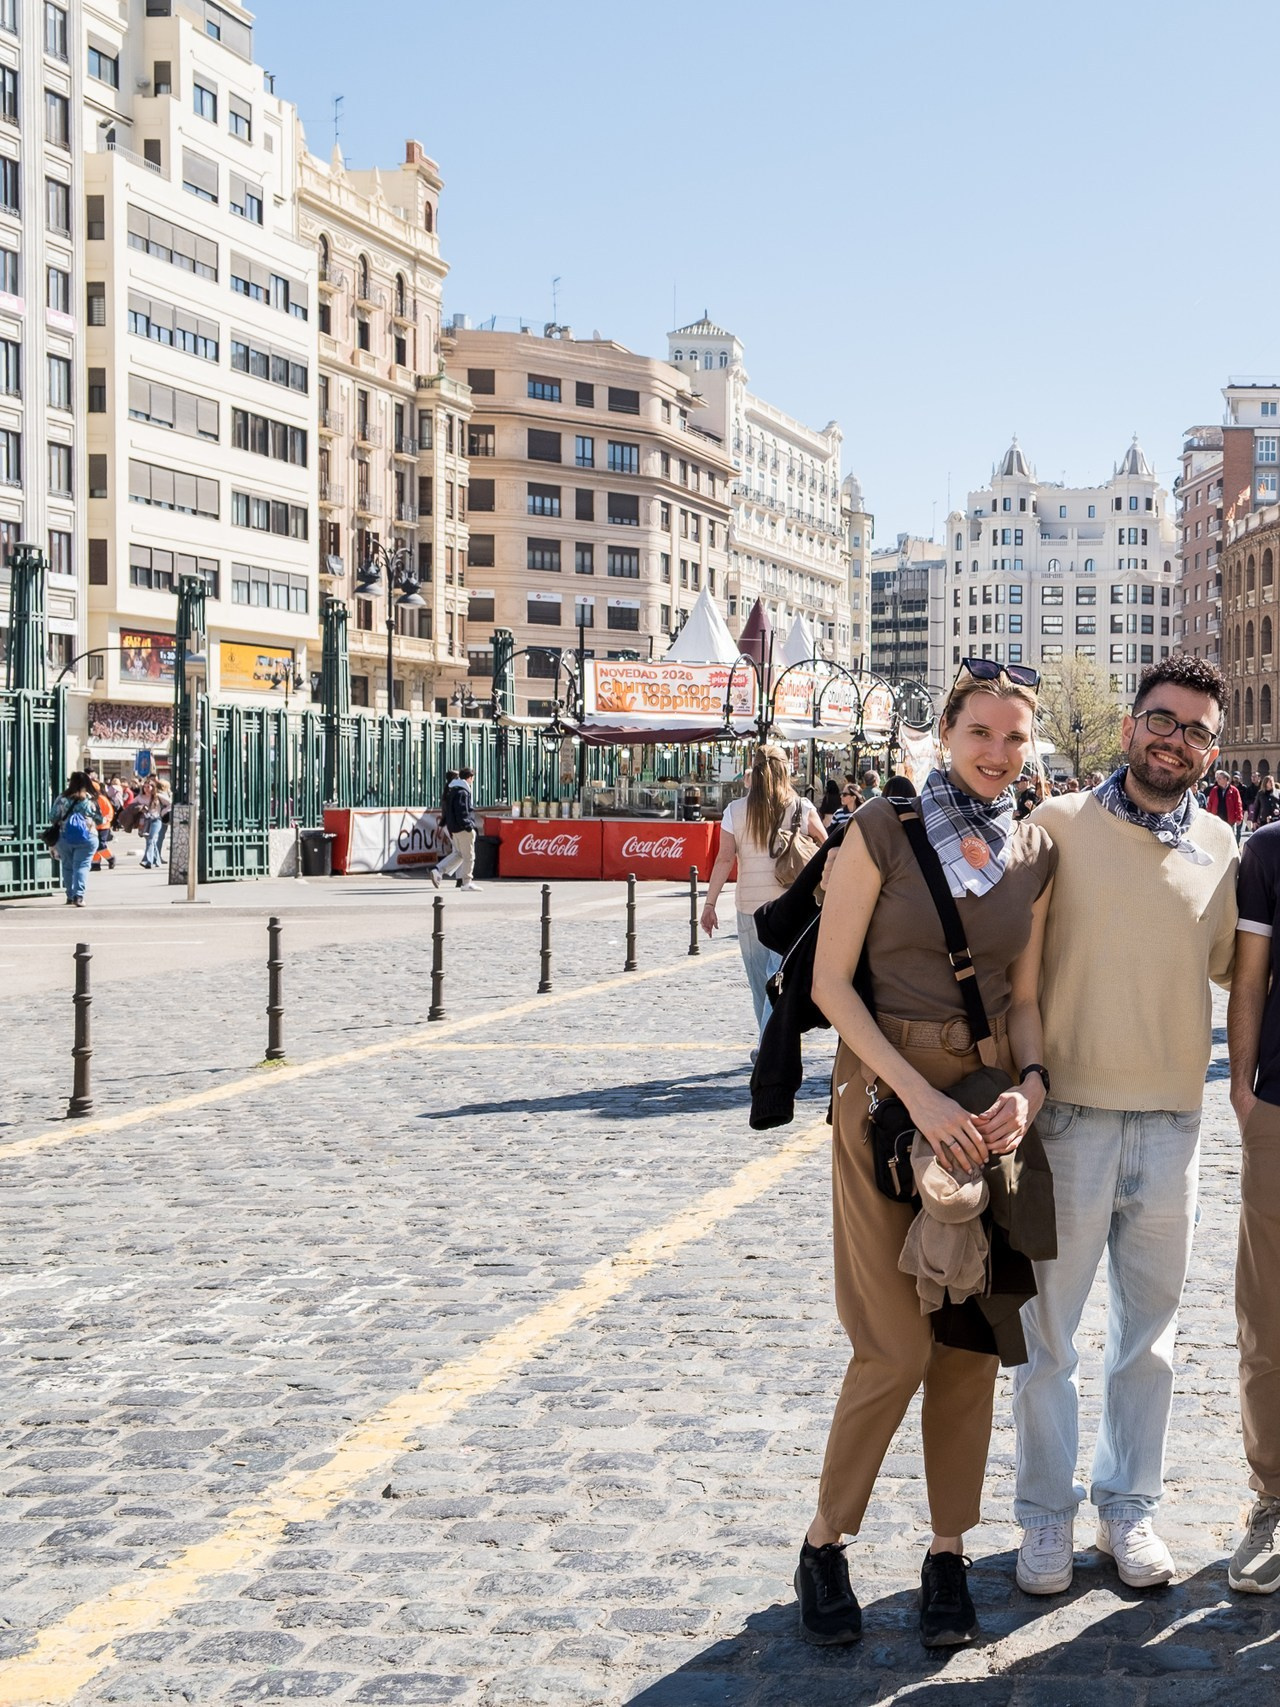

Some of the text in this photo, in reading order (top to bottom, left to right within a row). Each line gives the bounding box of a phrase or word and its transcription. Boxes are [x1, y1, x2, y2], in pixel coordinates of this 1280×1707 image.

[599, 668, 657, 679] NOVEDAD
[600, 678, 711, 697] churros con
[642, 691, 722, 710] toppings
[518, 833, 582, 856] Coca-Cola
[622, 836, 687, 858] Coca-Cola
